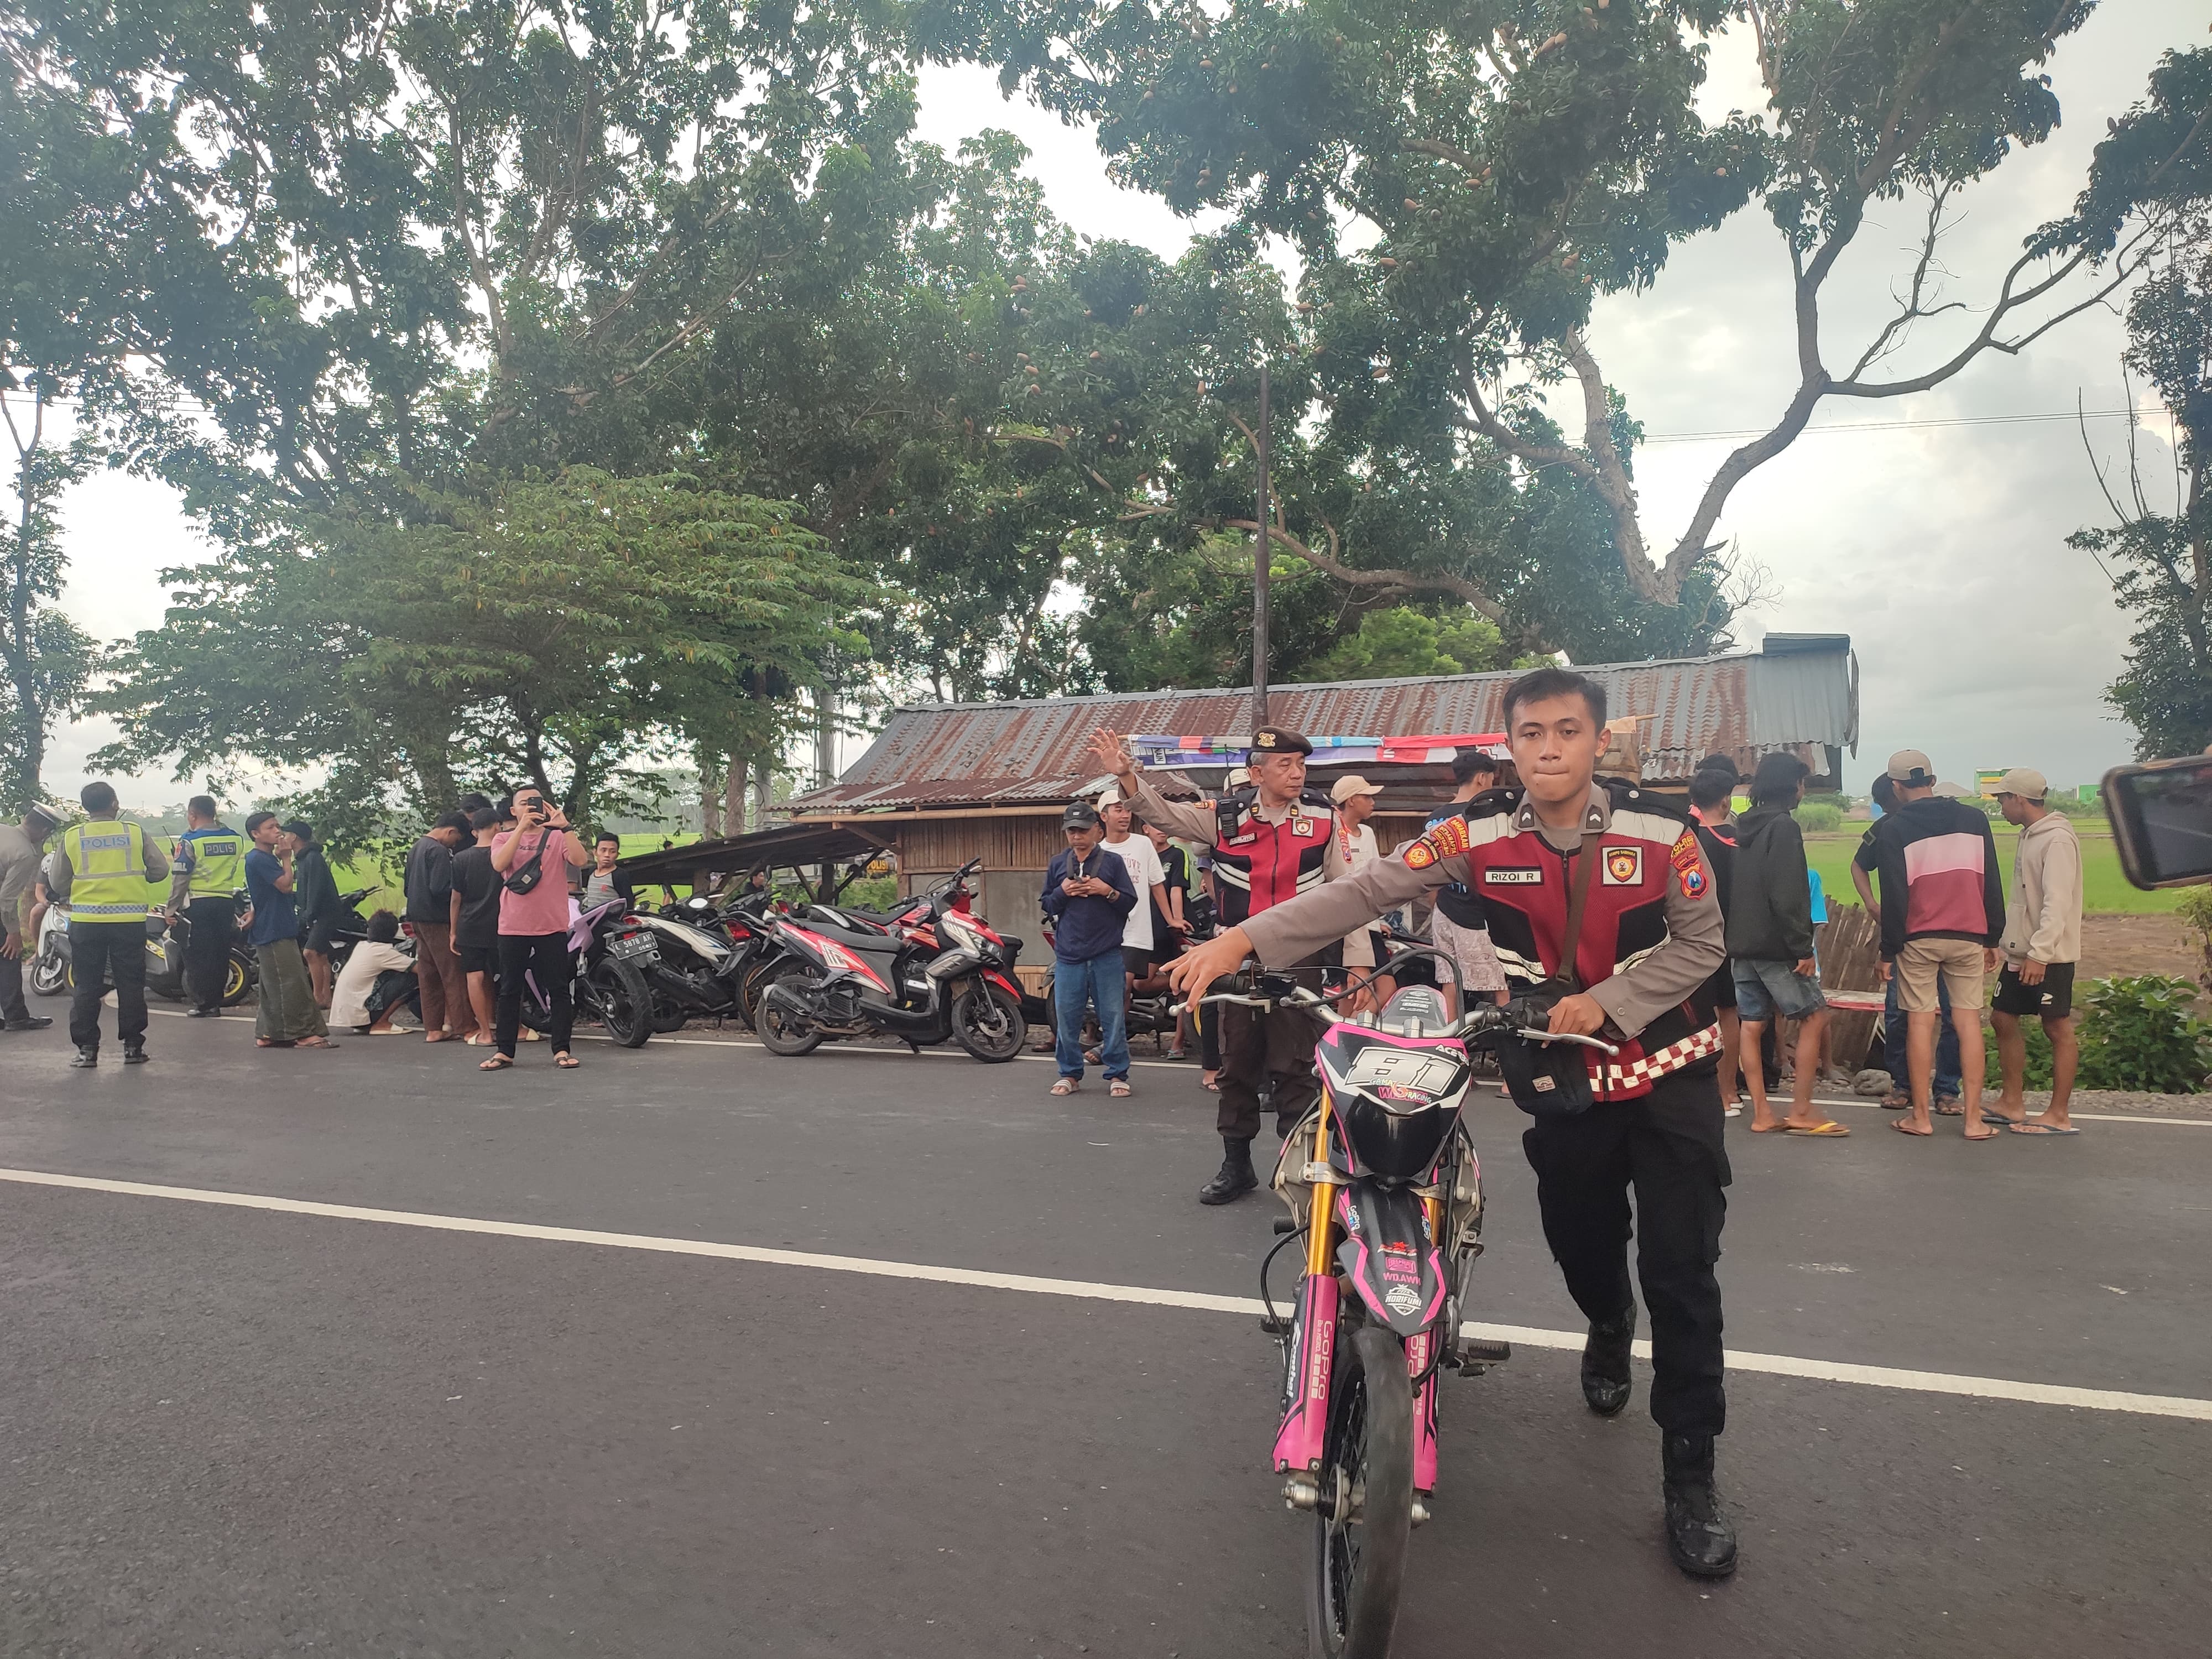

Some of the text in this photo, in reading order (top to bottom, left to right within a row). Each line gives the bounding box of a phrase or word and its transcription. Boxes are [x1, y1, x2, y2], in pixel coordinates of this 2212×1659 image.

[82, 837, 130, 849] POLISI
[206, 843, 236, 854] POLISI
[1491, 873, 1533, 881] RIZQI R
[643, 933, 653, 942] AK
[1345, 1047, 1460, 1097] 81
[1370, 1078, 1393, 1087] GAMA
[1407, 1092, 1432, 1104] RACING
[1318, 1320, 1332, 1400] GoPro
[1408, 1335, 1419, 1378] Pro
